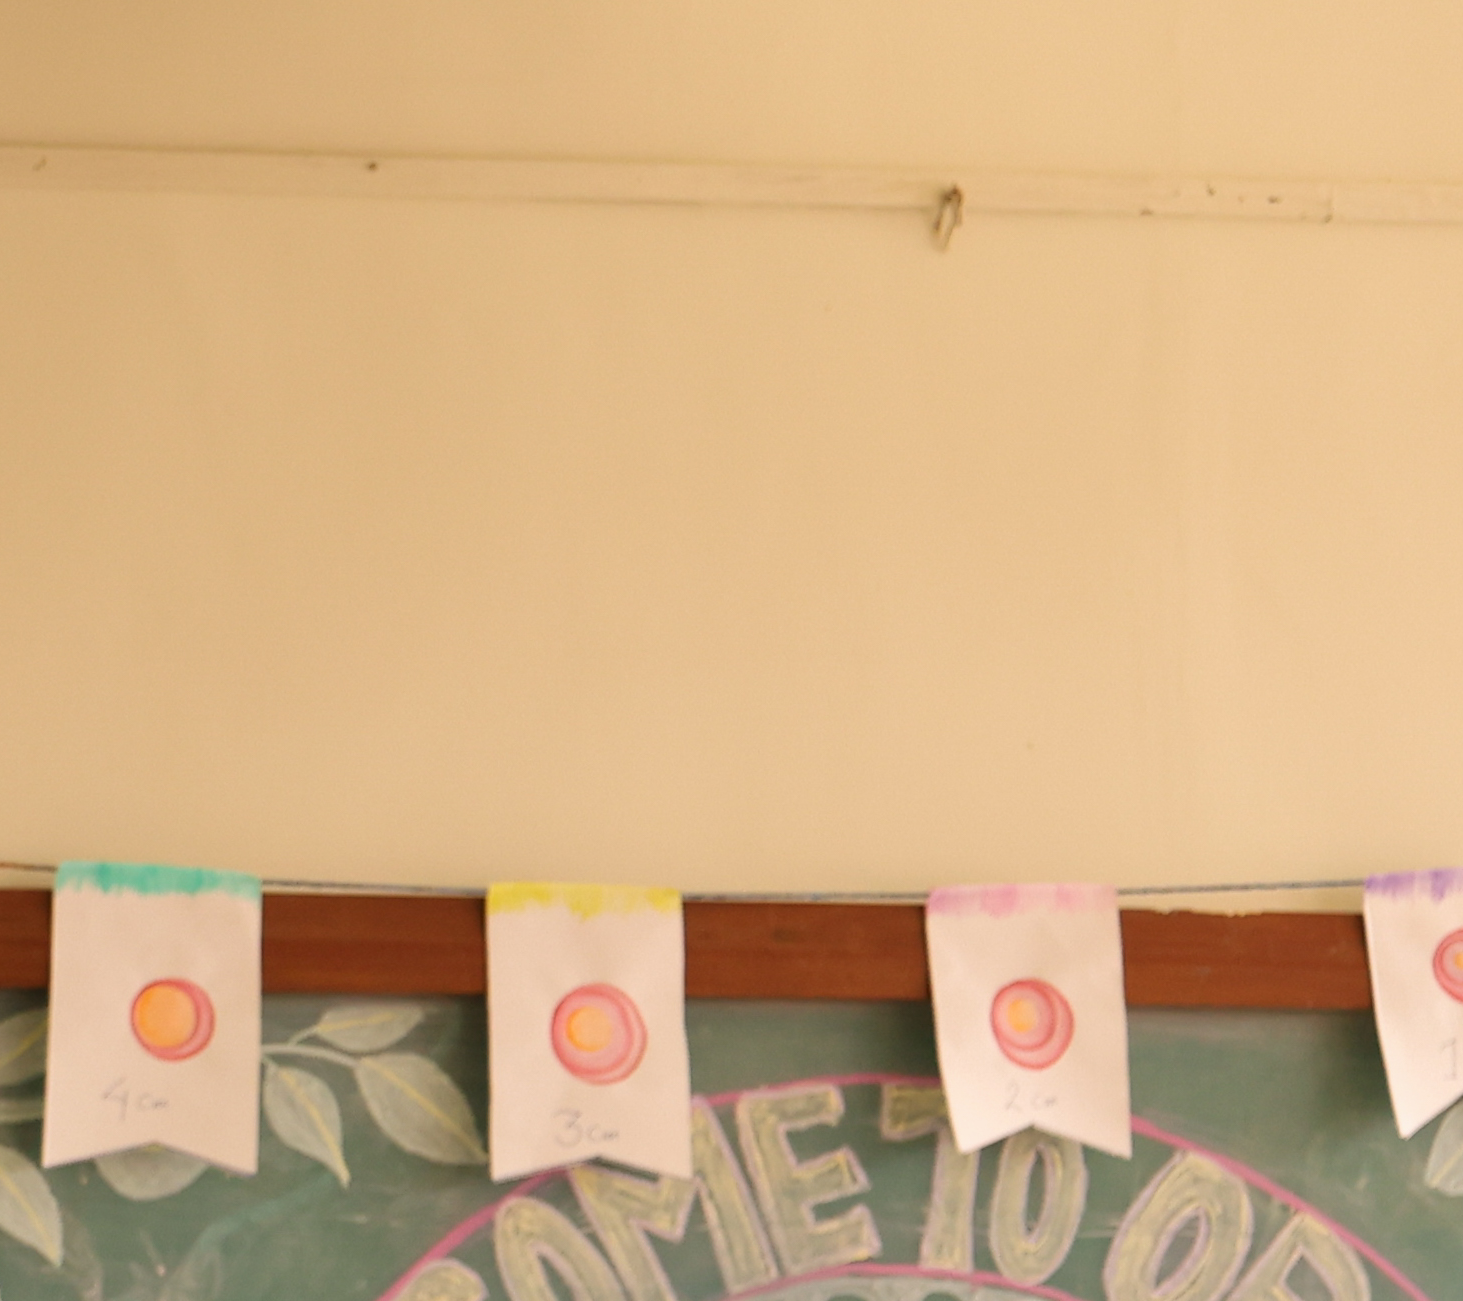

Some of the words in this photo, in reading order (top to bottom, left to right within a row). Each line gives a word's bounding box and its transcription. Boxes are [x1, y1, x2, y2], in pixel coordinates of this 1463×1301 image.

[103, 1077, 129, 1121] 4
[1005, 1077, 1023, 1113] 2
[552, 1108, 583, 1150] 3
